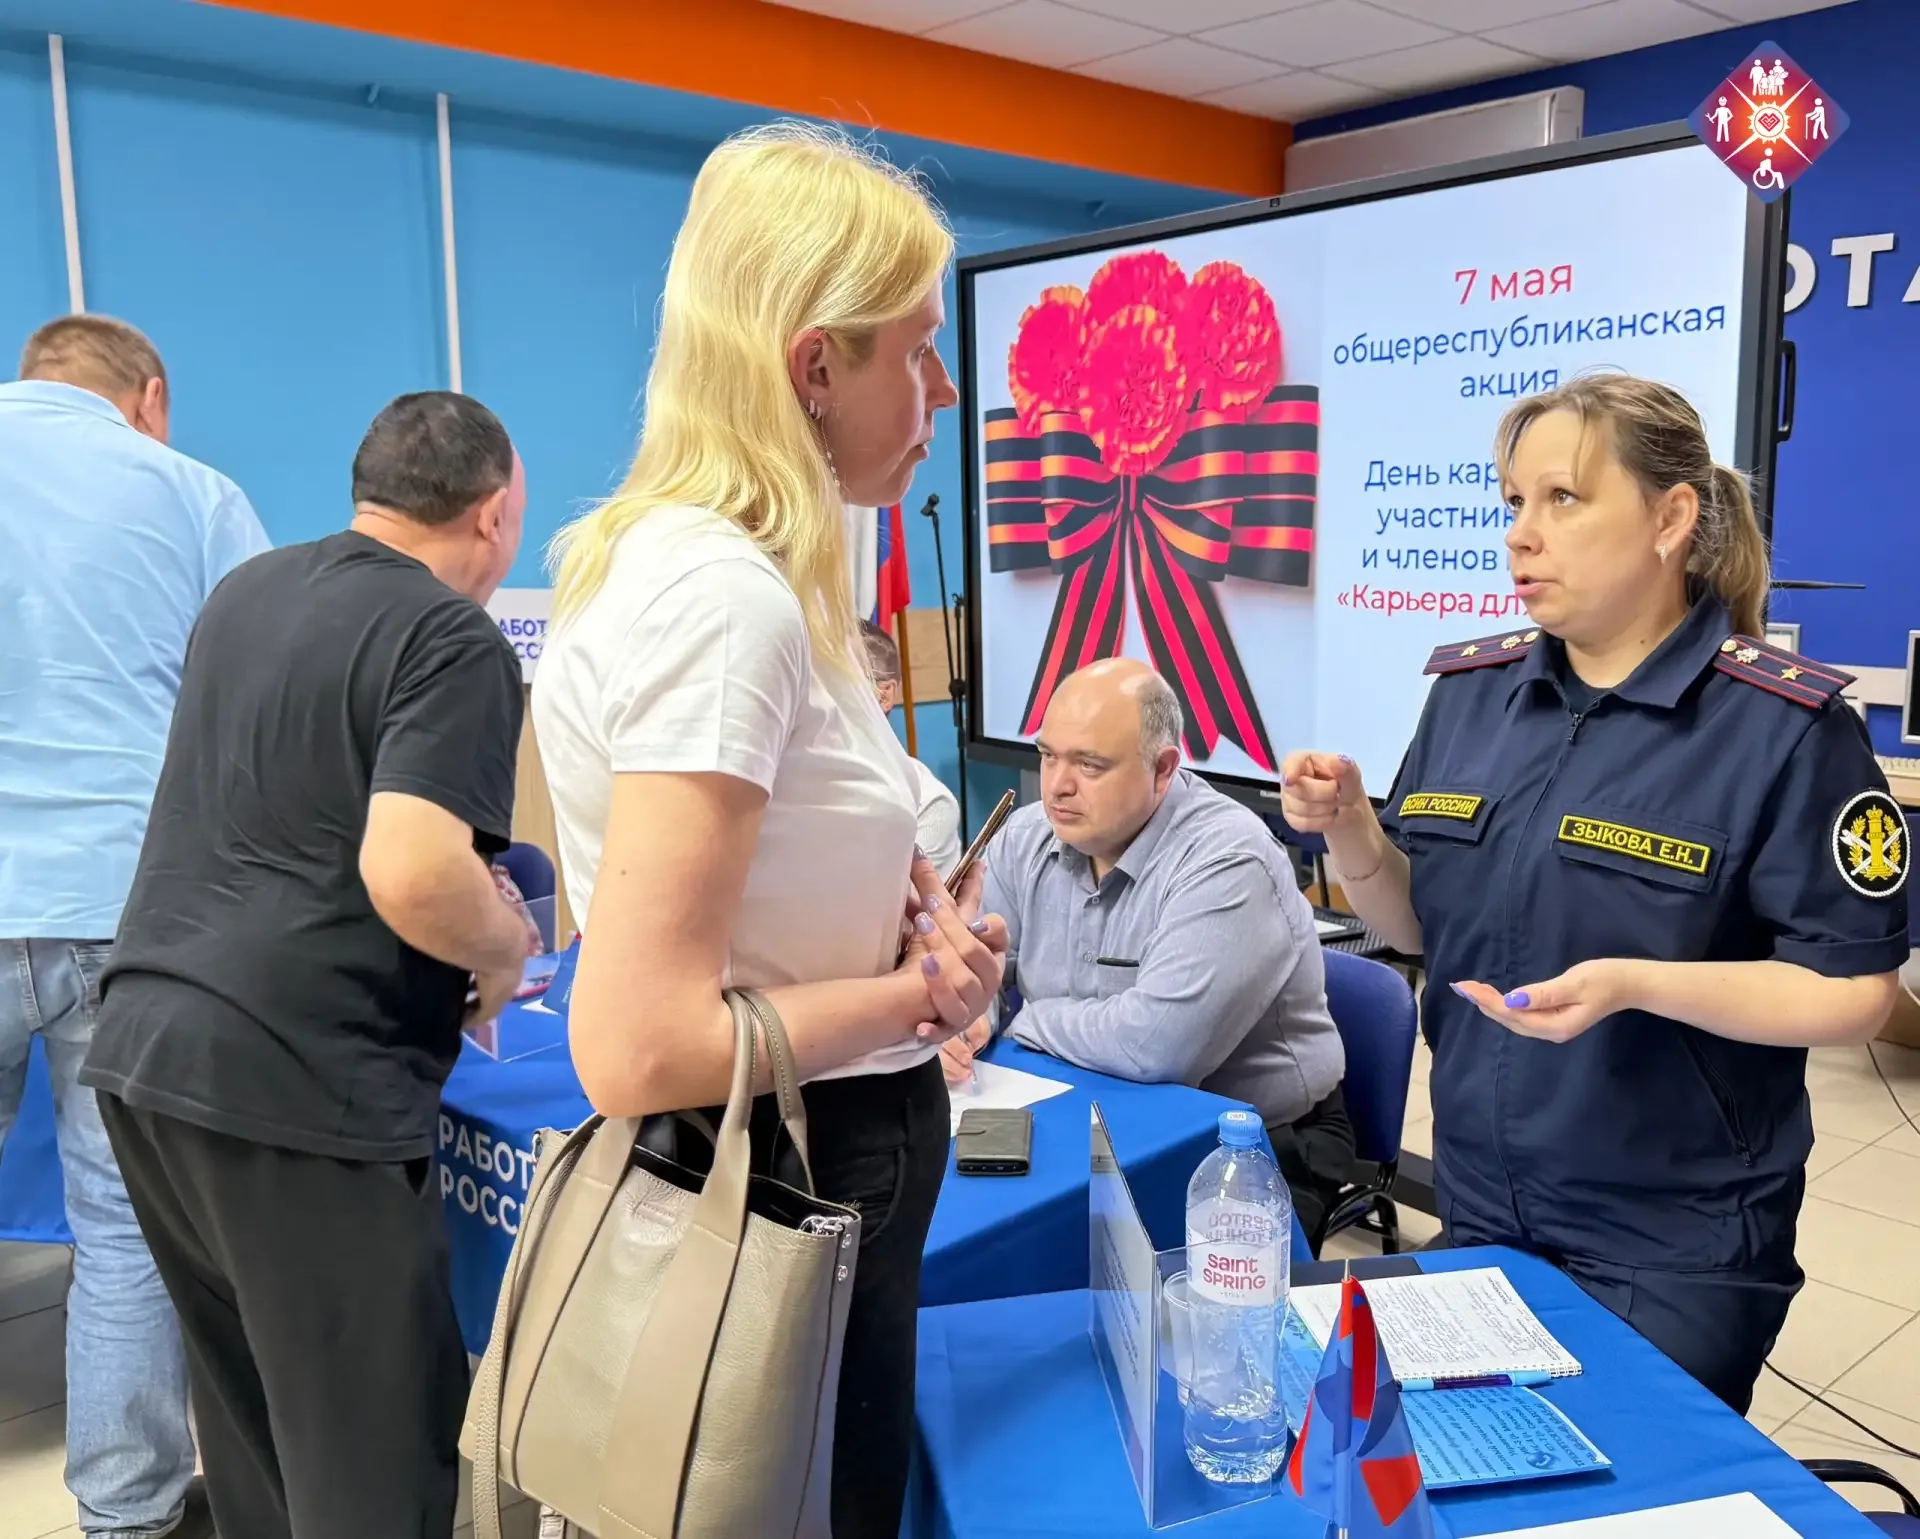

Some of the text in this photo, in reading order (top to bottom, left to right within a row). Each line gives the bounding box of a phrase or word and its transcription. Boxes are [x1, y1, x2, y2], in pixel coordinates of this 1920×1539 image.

[1454, 264, 1573, 305] 7 мая
[1333, 304, 1726, 365] общереспубликанская
[1459, 368, 1559, 399] акция
[1364, 459, 1441, 492] День
[1362, 548, 1379, 569] и
[1386, 545, 1498, 571] членов
[1336, 583, 1528, 619] «Карьера дл
[1427, 797, 1476, 814] РОССИИ
[1571, 822, 1694, 865] ЗЫКОВА Е.Н.
[439, 1112, 537, 1191] РАБОТ
[439, 1163, 524, 1235] РОСС
[1203, 1268, 1266, 1290] SPRING
